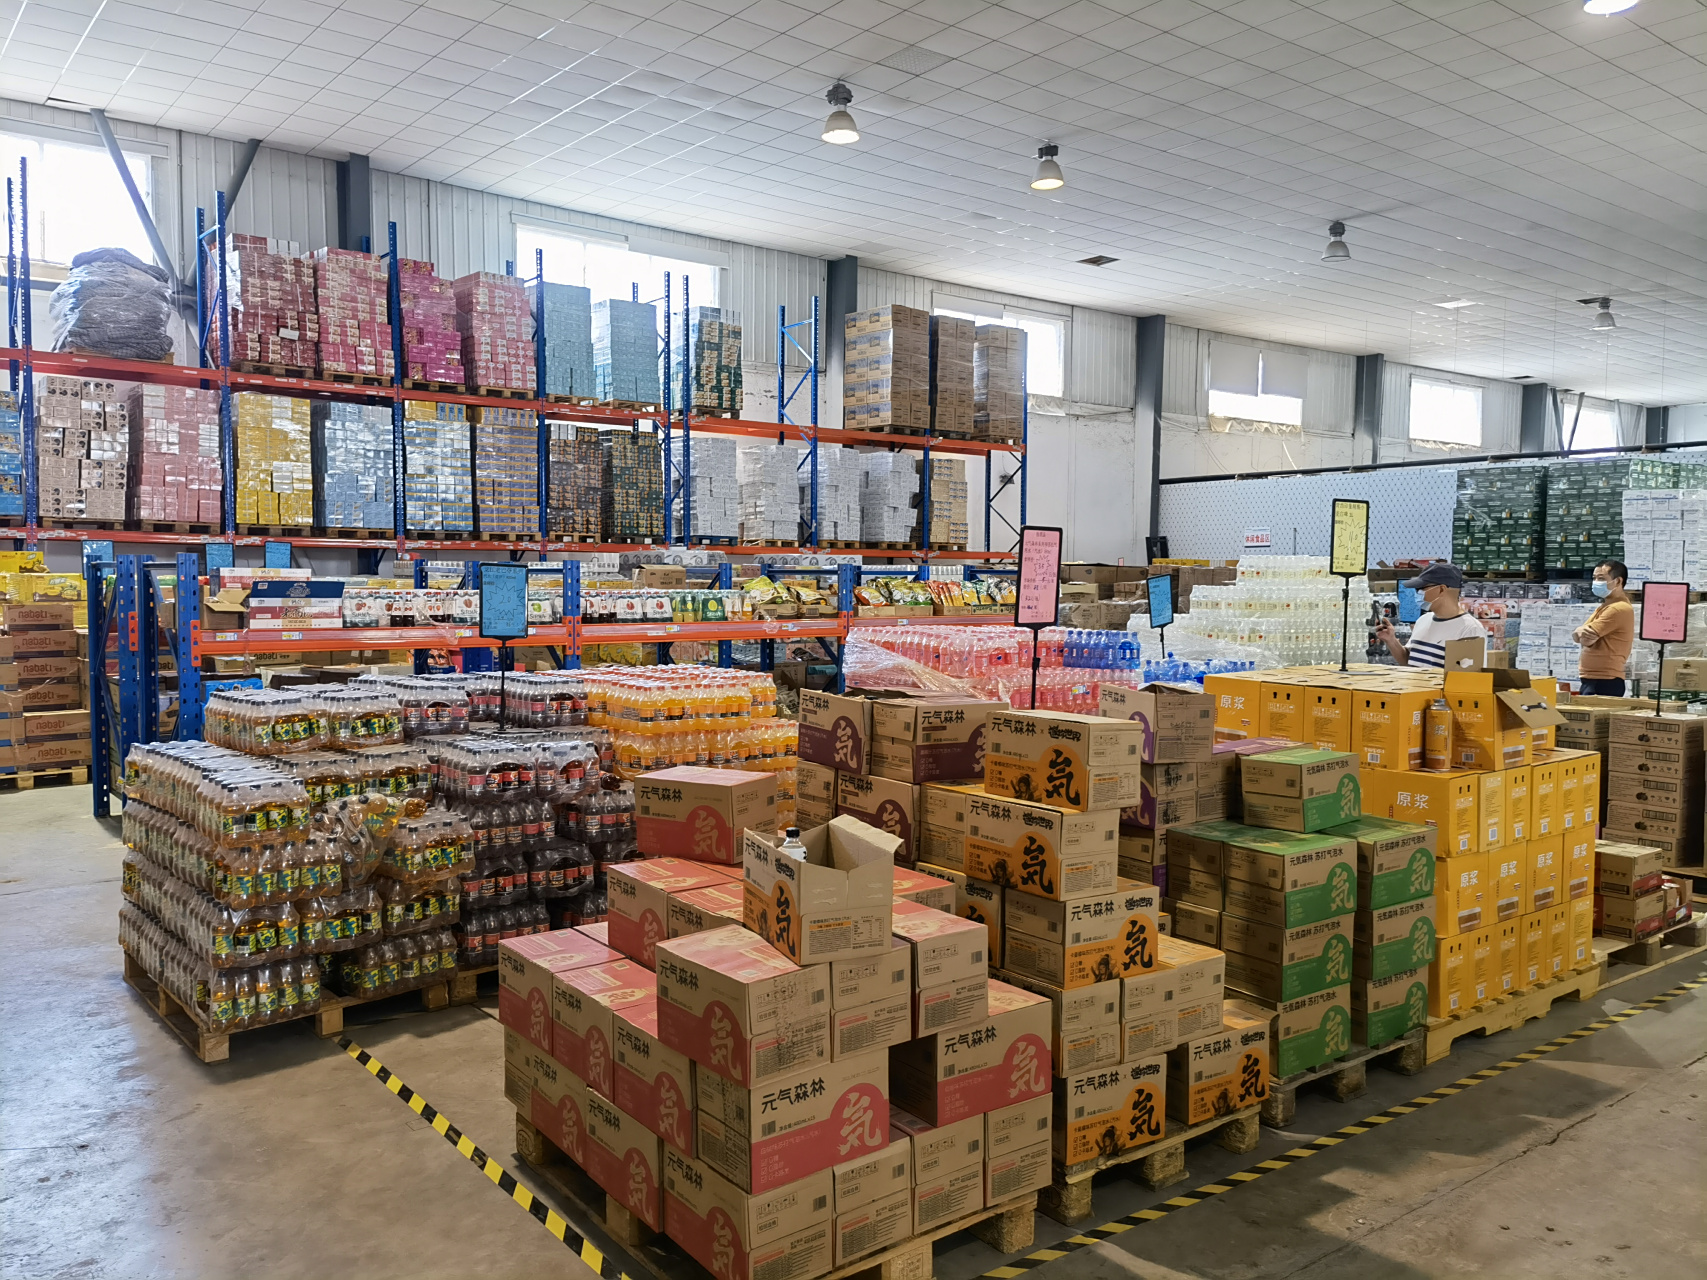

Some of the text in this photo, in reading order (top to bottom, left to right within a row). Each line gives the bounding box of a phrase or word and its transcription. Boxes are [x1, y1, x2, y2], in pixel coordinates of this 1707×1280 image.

[18, 609, 47, 619] nabati
[22, 636, 51, 646] nabati
[23, 663, 52, 673] nabati
[25, 690, 54, 700] nabati
[801, 693, 829, 711] 元气森林
[1101, 689, 1126, 706] 元气森林
[1220, 694, 1245, 710] 原浆
[36, 720, 64, 730] nabati
[921, 709, 965, 725] 元气森林
[991, 717, 1037, 737] 元气森林
[38, 747, 66, 757] nabati
[839, 773, 873, 794] 元气森林
[640, 786, 682, 803] 元气森林
[1396, 791, 1428, 808] 原浆
[969, 800, 1012, 822] 元气森林
[745, 837, 769, 866] 元气森林
[1537, 852, 1553, 868] 原浆
[1573, 843, 1587, 859] 原浆
[1460, 870, 1478, 887] 原浆
[1500, 860, 1517, 877] 原浆
[609, 876, 636, 899] 元气森林
[671, 904, 704, 930] 元气森林
[1071, 899, 1114, 921] 元气森林
[500, 952, 525, 976] 元气森林
[660, 959, 699, 991] 元气森林
[554, 985, 582, 1014] 元气森林
[617, 1026, 650, 1060] 元气森林
[944, 1025, 997, 1056] 元气森林
[1193, 1037, 1232, 1061] 元气森林
[1073, 1069, 1120, 1096] 元气森林
[761, 1077, 826, 1114] 元气森林
[588, 1098, 620, 1133] 元气森林
[667, 1150, 703, 1191] 元气森林
